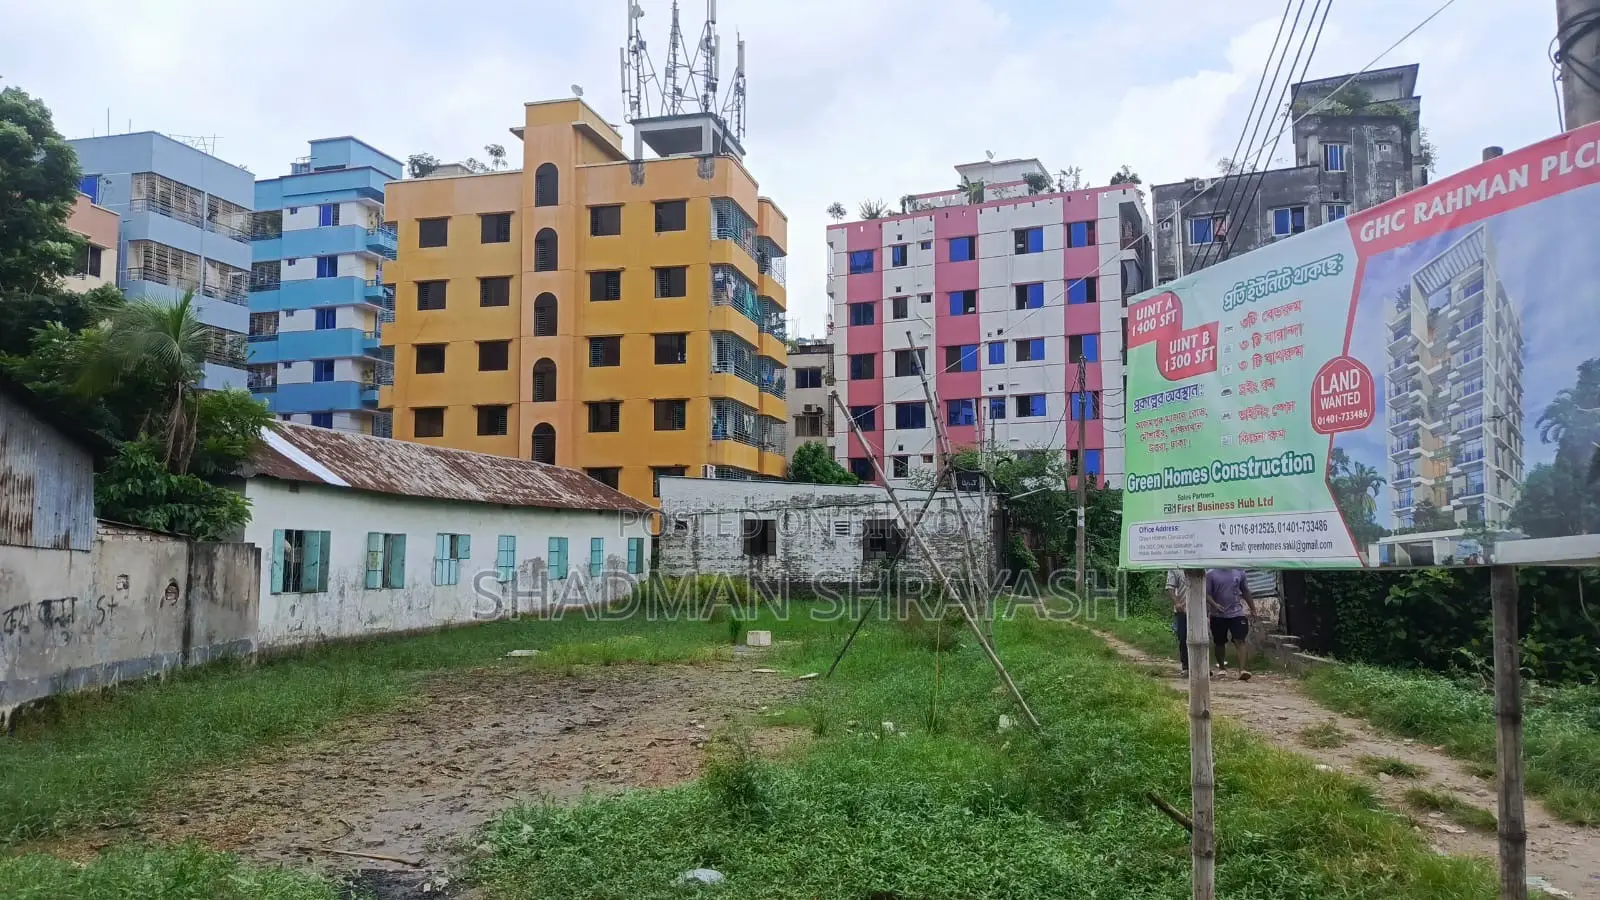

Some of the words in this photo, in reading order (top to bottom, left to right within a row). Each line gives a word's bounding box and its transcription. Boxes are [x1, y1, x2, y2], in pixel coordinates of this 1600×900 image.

[1359, 208, 1407, 243] GHC
[1413, 164, 1530, 225] RAHMAN
[1136, 301, 1163, 321] UINT
[1165, 296, 1173, 310] A
[1132, 319, 1157, 337] 1400
[1159, 309, 1178, 327] SFT
[1169, 334, 1199, 355] UINT
[1202, 331, 1210, 346] B
[1164, 353, 1191, 373] 1300
[1194, 346, 1215, 364] SFT
[1320, 368, 1360, 395] LAND
[1320, 391, 1361, 411] WANTED
[1317, 408, 1368, 426] 01401-733486
[1127, 473, 1161, 493] Green
[1163, 466, 1209, 489] Homes
[1210, 450, 1315, 483] Construction
[1177, 503, 1195, 513] First
[1197, 500, 1235, 512] Business
[1237, 499, 1255, 509] Hub
[1257, 496, 1274, 508] Ltd
[1138, 526, 1155, 534] Office
[1229, 522, 1277, 535] 01716-912525,
[1277, 519, 1328, 533] 01401-733486
